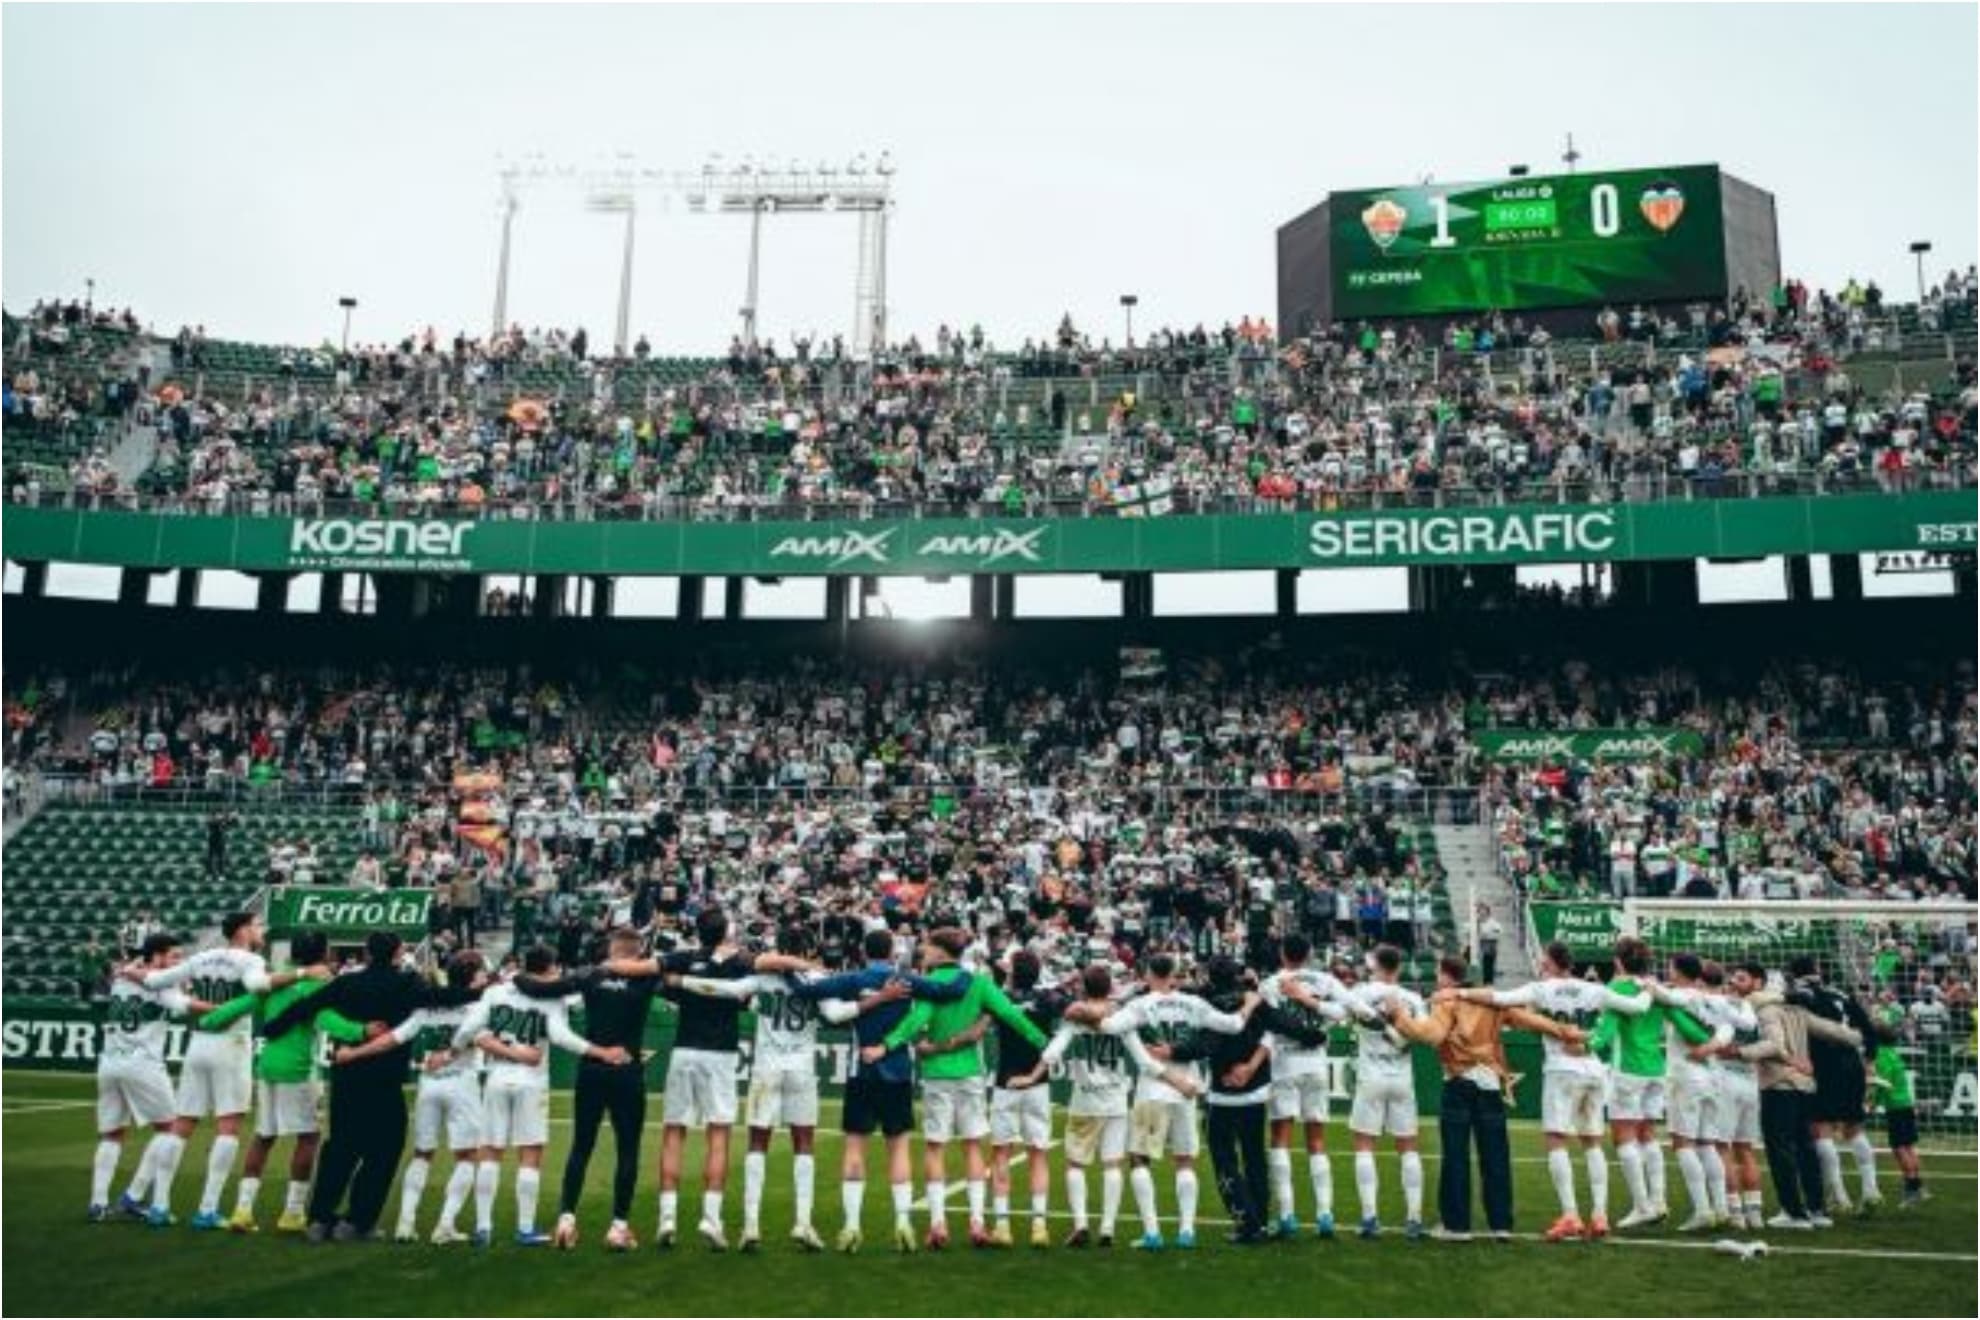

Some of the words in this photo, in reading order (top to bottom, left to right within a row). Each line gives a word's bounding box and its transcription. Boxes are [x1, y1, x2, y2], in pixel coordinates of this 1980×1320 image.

[1428, 193, 1457, 247] 1
[1591, 184, 1619, 236] 0
[1310, 511, 1615, 557] SERIGRAFIC
